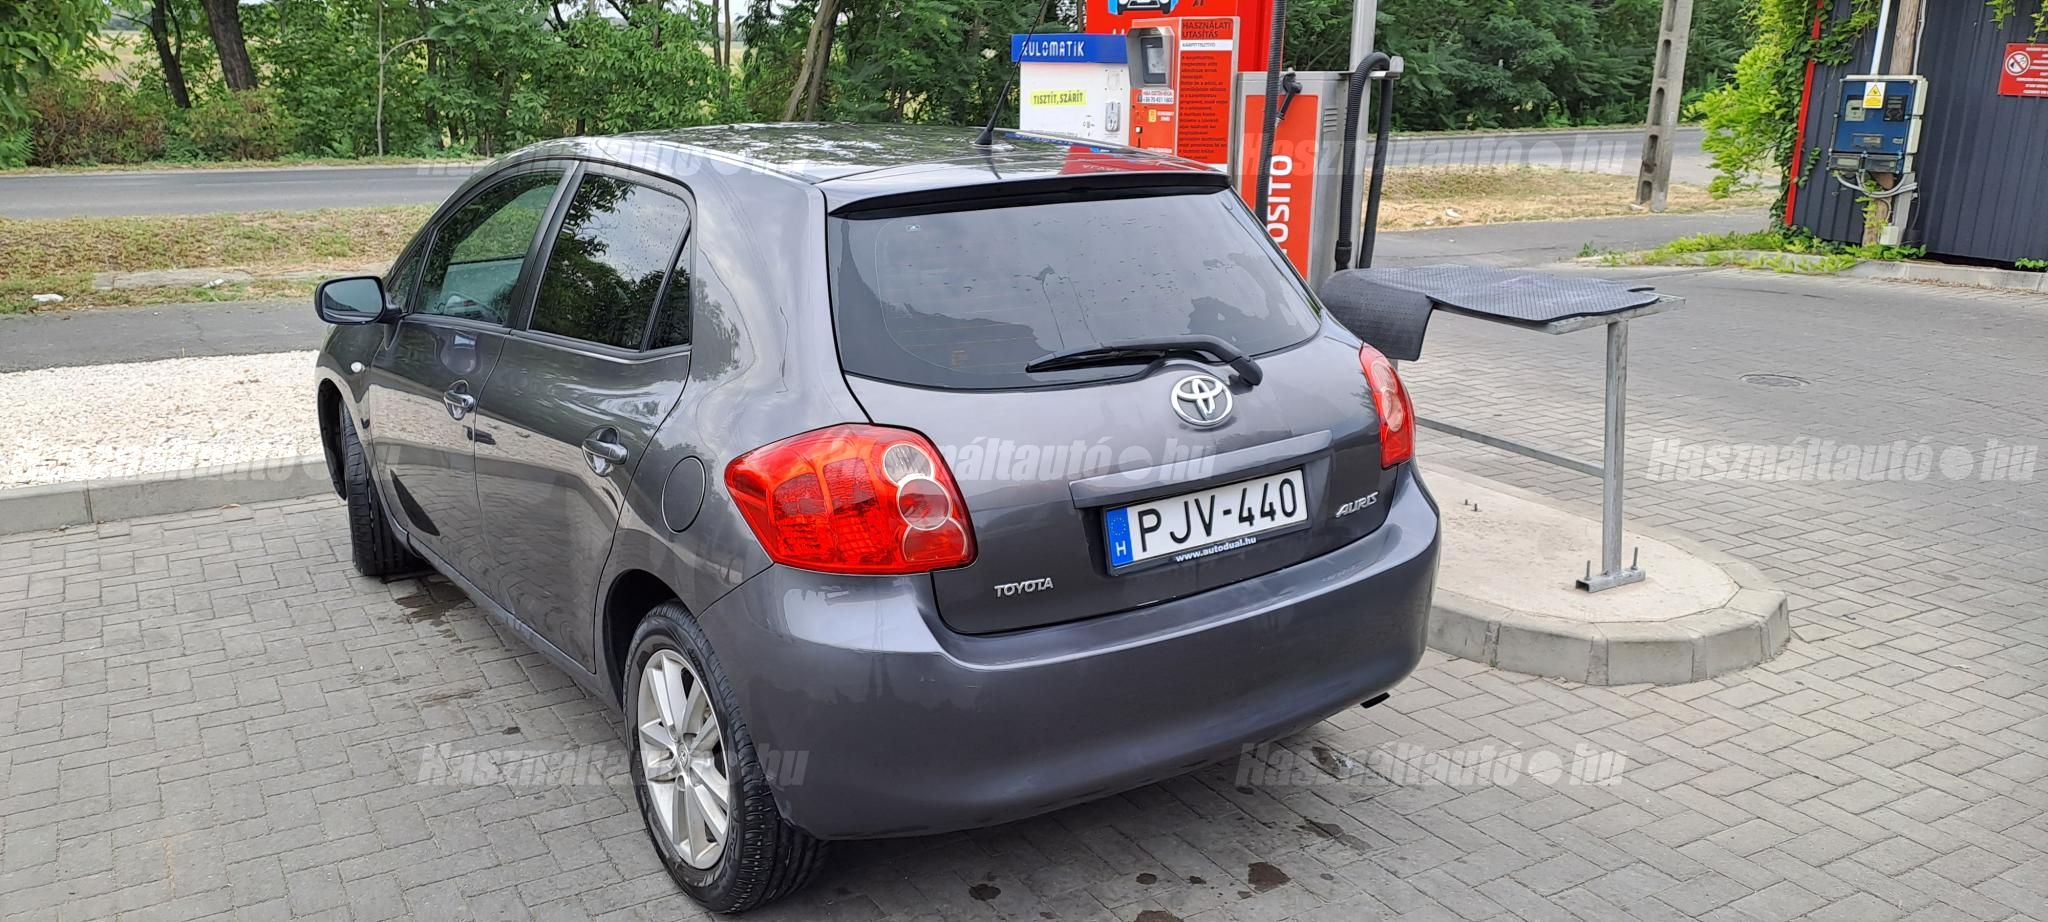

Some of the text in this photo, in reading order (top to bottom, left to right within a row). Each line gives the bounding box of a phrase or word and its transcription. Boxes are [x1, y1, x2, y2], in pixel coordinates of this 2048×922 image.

[1267, 155, 1293, 257] OSITO
[1137, 478, 1298, 553] PJV-440
[1335, 491, 1379, 518] AURIS
[1115, 541, 1127, 557] H
[1175, 536, 1257, 563] www.autodual.hu
[994, 577, 1054, 598] TOYOTA
